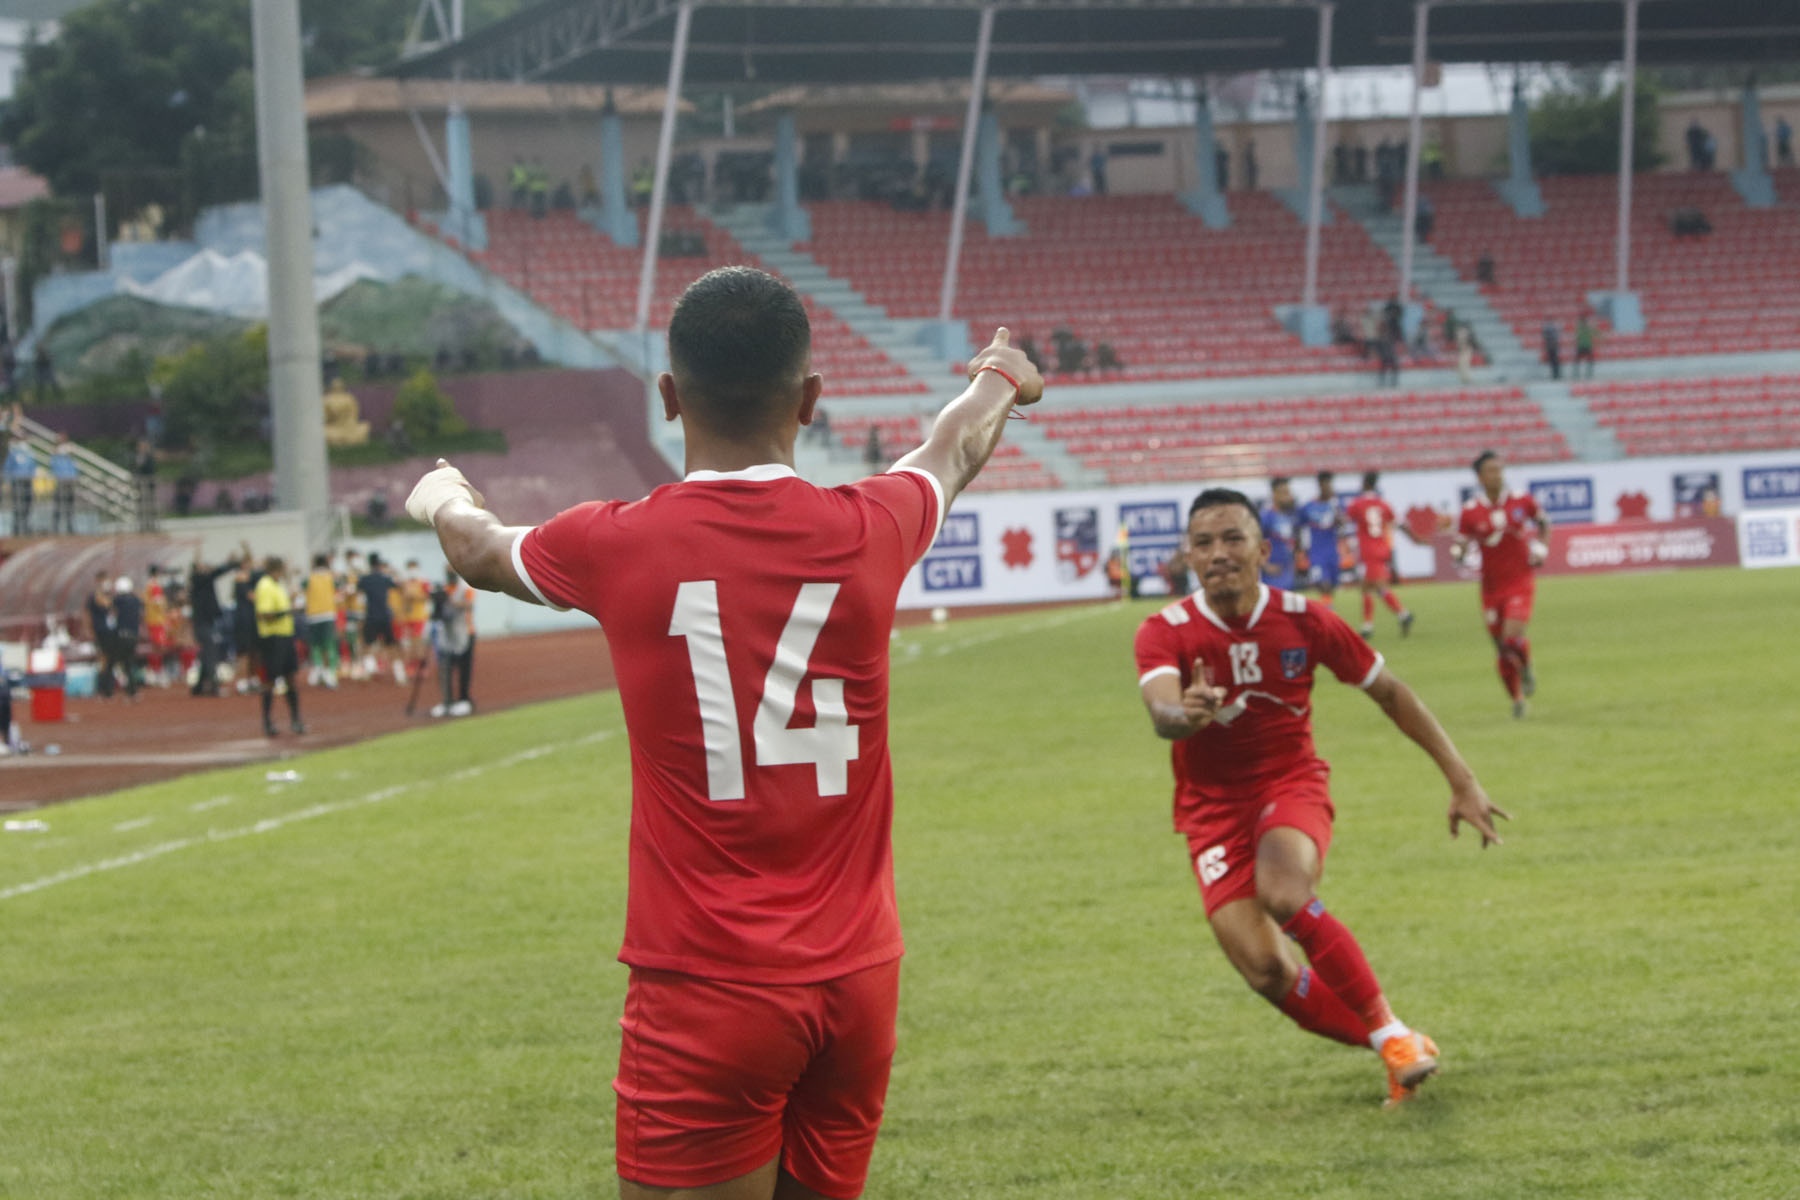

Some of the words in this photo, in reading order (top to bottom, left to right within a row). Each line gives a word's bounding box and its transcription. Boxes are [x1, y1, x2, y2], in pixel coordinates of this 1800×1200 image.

[936, 517, 975, 544] TW
[927, 561, 977, 587] CTY
[1228, 642, 1263, 685] 13
[668, 580, 859, 801] 14
